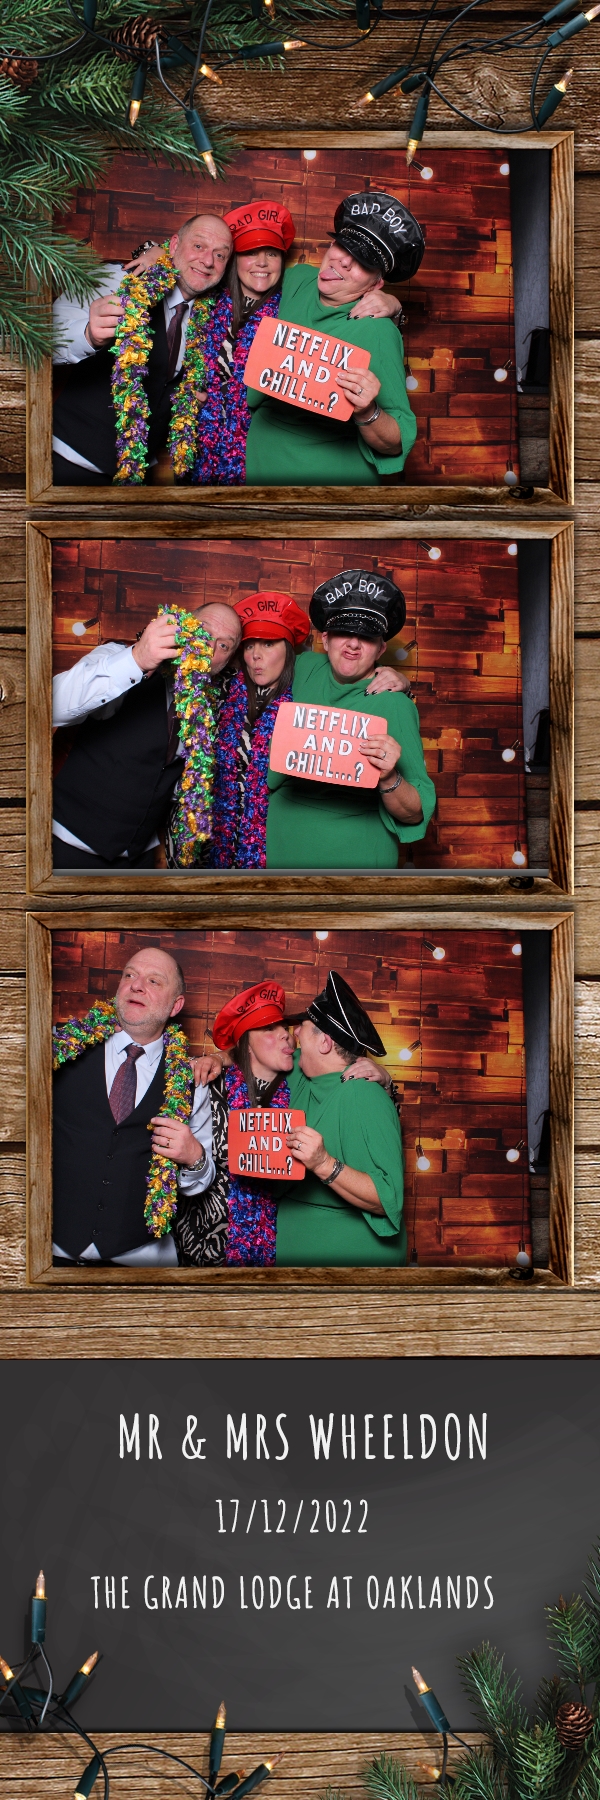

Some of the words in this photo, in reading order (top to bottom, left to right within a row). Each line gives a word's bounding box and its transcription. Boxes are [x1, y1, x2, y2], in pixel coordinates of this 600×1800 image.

[351, 202, 381, 216] BAD
[382, 207, 407, 234] BOY
[272, 322, 354, 371] NETFLIX
[279, 354, 331, 383] AND
[259, 367, 339, 413] CHILL...?
[325, 582, 353, 604] BAD
[358, 579, 384, 599] BOY
[257, 600, 280, 613] GIRL
[293, 705, 371, 740] NETFLIX
[303, 734, 353, 756] AND
[285, 750, 364, 783] CHILL...?
[239, 1111, 293, 1134] NETFLIX
[247, 1135, 283, 1152] AND
[238, 1152, 294, 1176] CHILL...?
